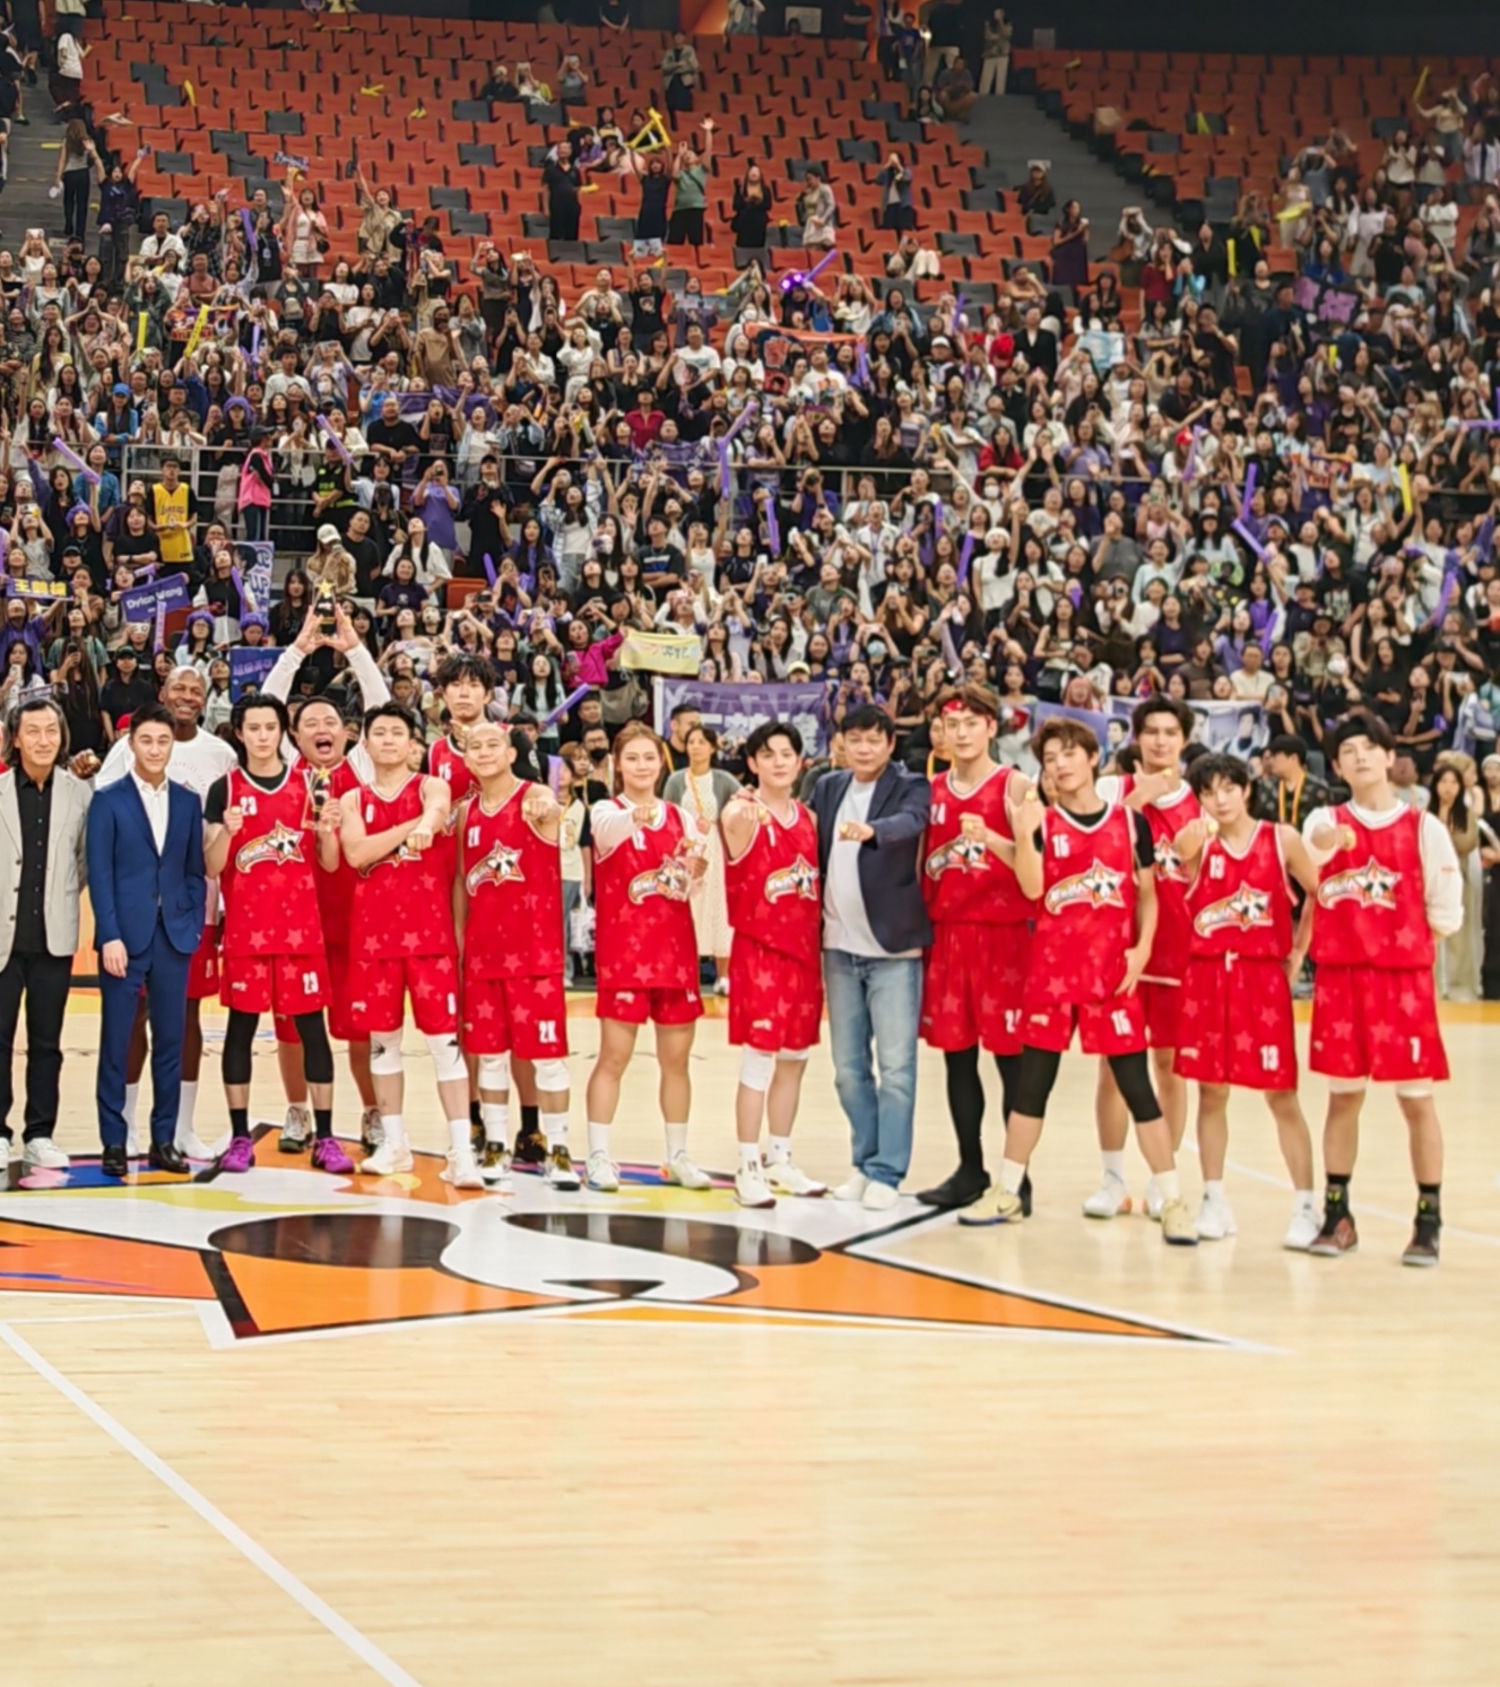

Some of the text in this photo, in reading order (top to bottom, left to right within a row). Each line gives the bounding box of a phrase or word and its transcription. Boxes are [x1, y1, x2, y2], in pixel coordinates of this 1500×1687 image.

[126, 586, 183, 610] Dylan Wang
[240, 795, 258, 816] 23
[302, 971, 319, 995] 23
